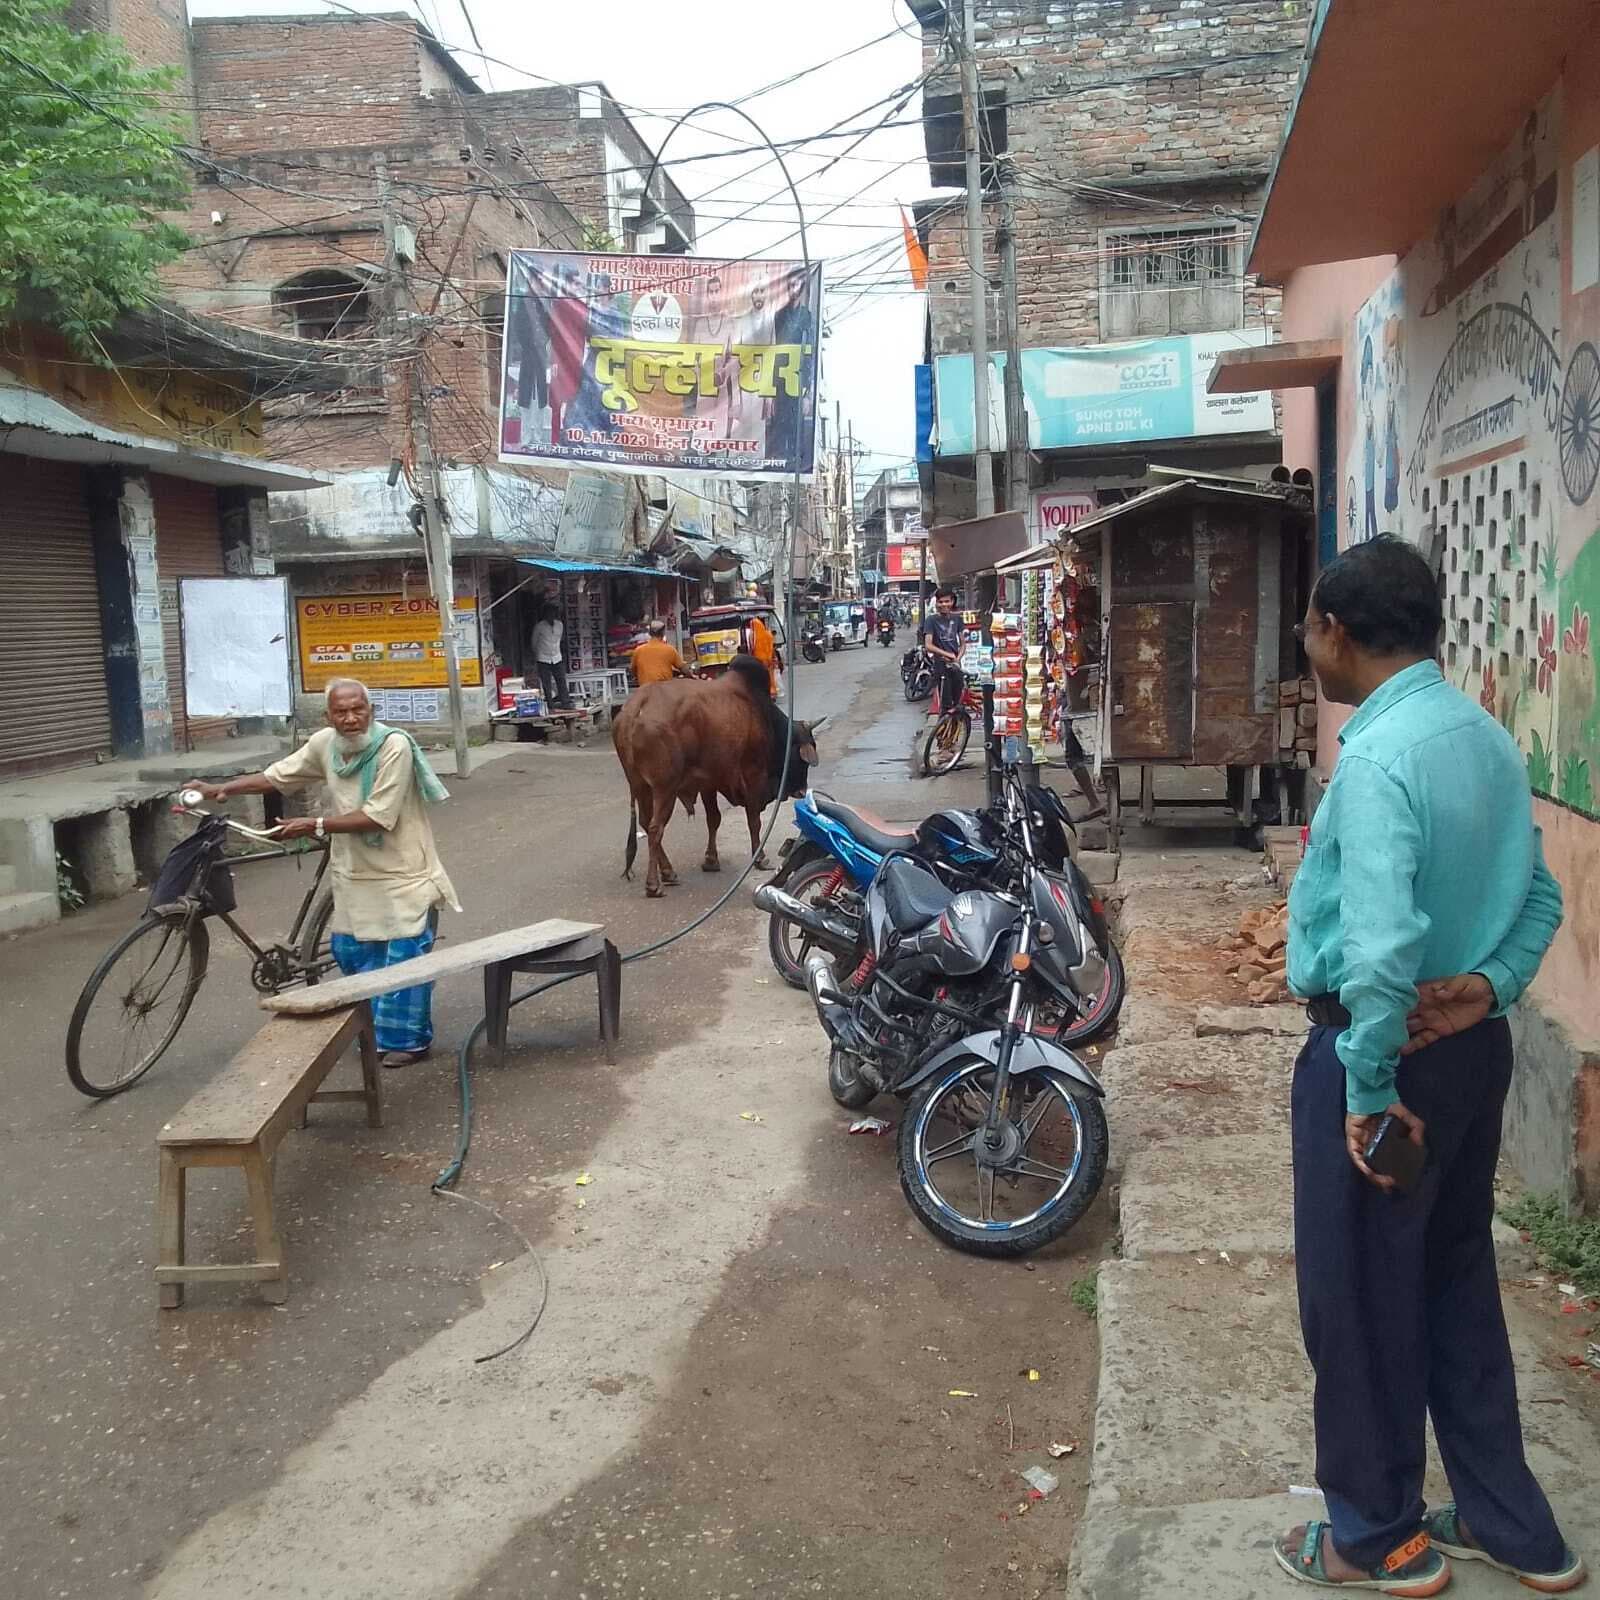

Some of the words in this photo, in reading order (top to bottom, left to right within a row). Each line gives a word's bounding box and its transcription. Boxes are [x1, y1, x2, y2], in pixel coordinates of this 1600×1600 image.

[1197, 351, 1219, 361] KHALS
[731, 343, 812, 397] घर
[1120, 356, 1169, 381] cozi
[1075, 409, 1113, 422] SUNO
[1116, 407, 1142, 418] TOH
[1075, 421, 1112, 435] APNE
[1115, 421, 1137, 431] DIL
[1140, 418, 1153, 430] KI
[304, 601, 384, 617] CYBER
[391, 599, 457, 615] ZON
